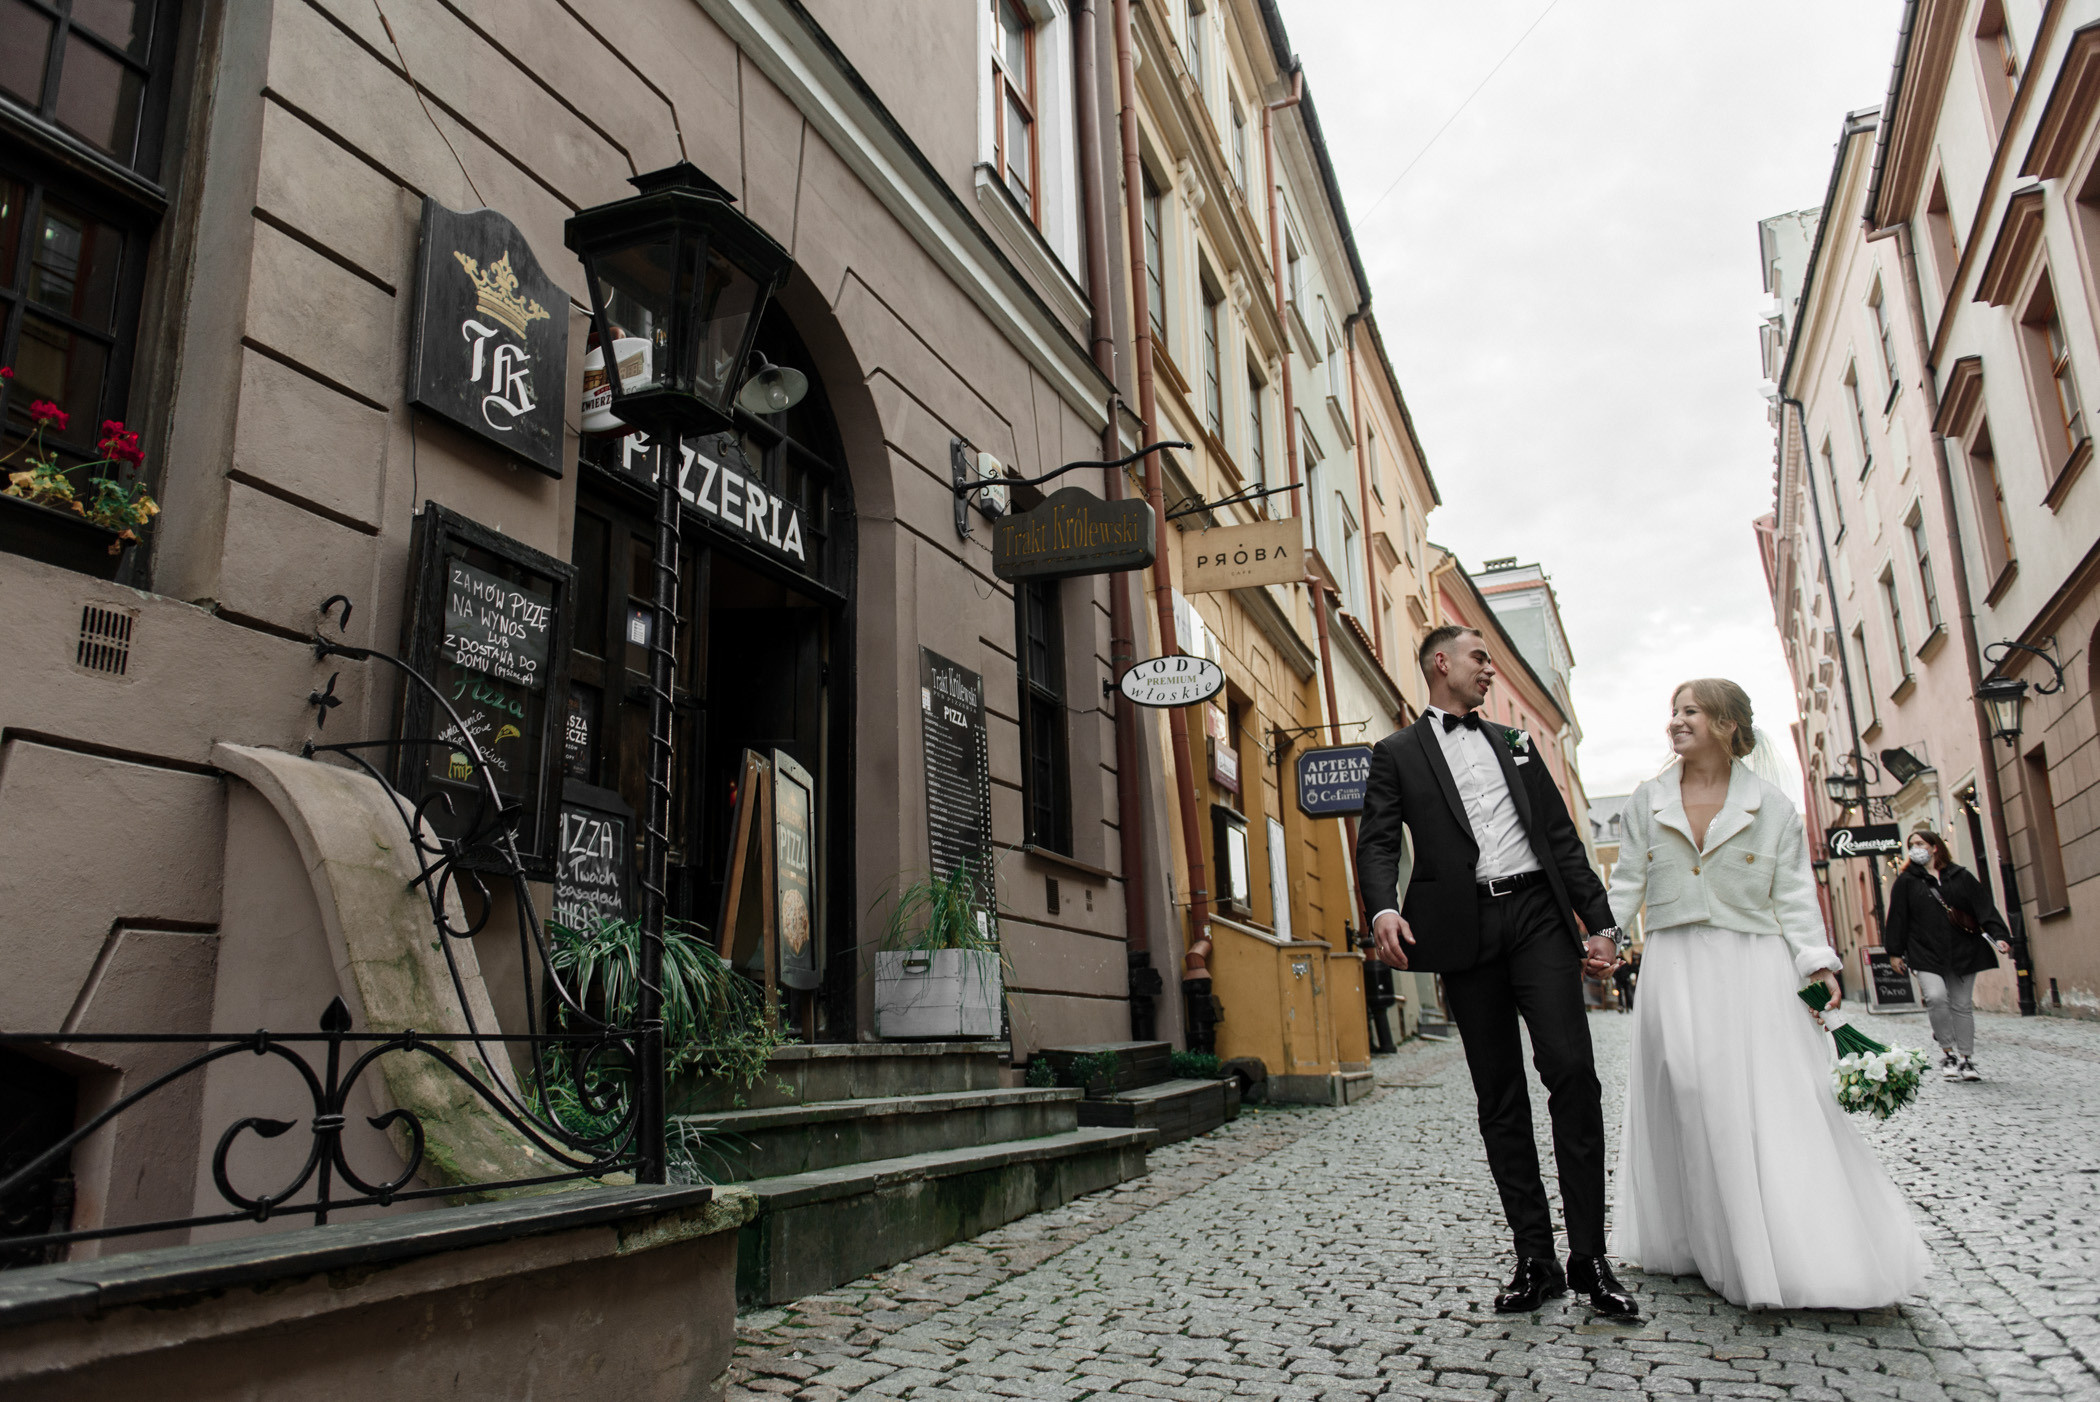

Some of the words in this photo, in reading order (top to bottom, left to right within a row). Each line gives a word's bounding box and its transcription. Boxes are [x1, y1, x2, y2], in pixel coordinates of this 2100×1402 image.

[582, 394, 612, 412] ZWIERZ
[1002, 519, 1046, 557] Trakt
[1053, 504, 1139, 550] Królewski
[453, 570, 505, 609] ZAMÓW
[509, 592, 551, 632] PIZZĘ
[453, 592, 473, 618] NA
[481, 606, 526, 639] WYNOS
[488, 631, 509, 648] LUB
[444, 634, 456, 647] Z
[460, 637, 515, 669] DOSTAWĄ
[520, 655, 537, 671] DO
[456, 650, 489, 672] DOMU
[1132, 659, 1211, 681] LODY
[1146, 674, 1197, 686] PREMIUM
[1131, 681, 1213, 701] włoskie
[566, 715, 588, 732] SZA
[943, 705, 968, 729] PIZZA
[1307, 756, 1370, 774] APTEKA
[1320, 788, 1360, 802] Cefarm
[559, 812, 613, 860] IZZA
[780, 825, 808, 873] PIZZA
